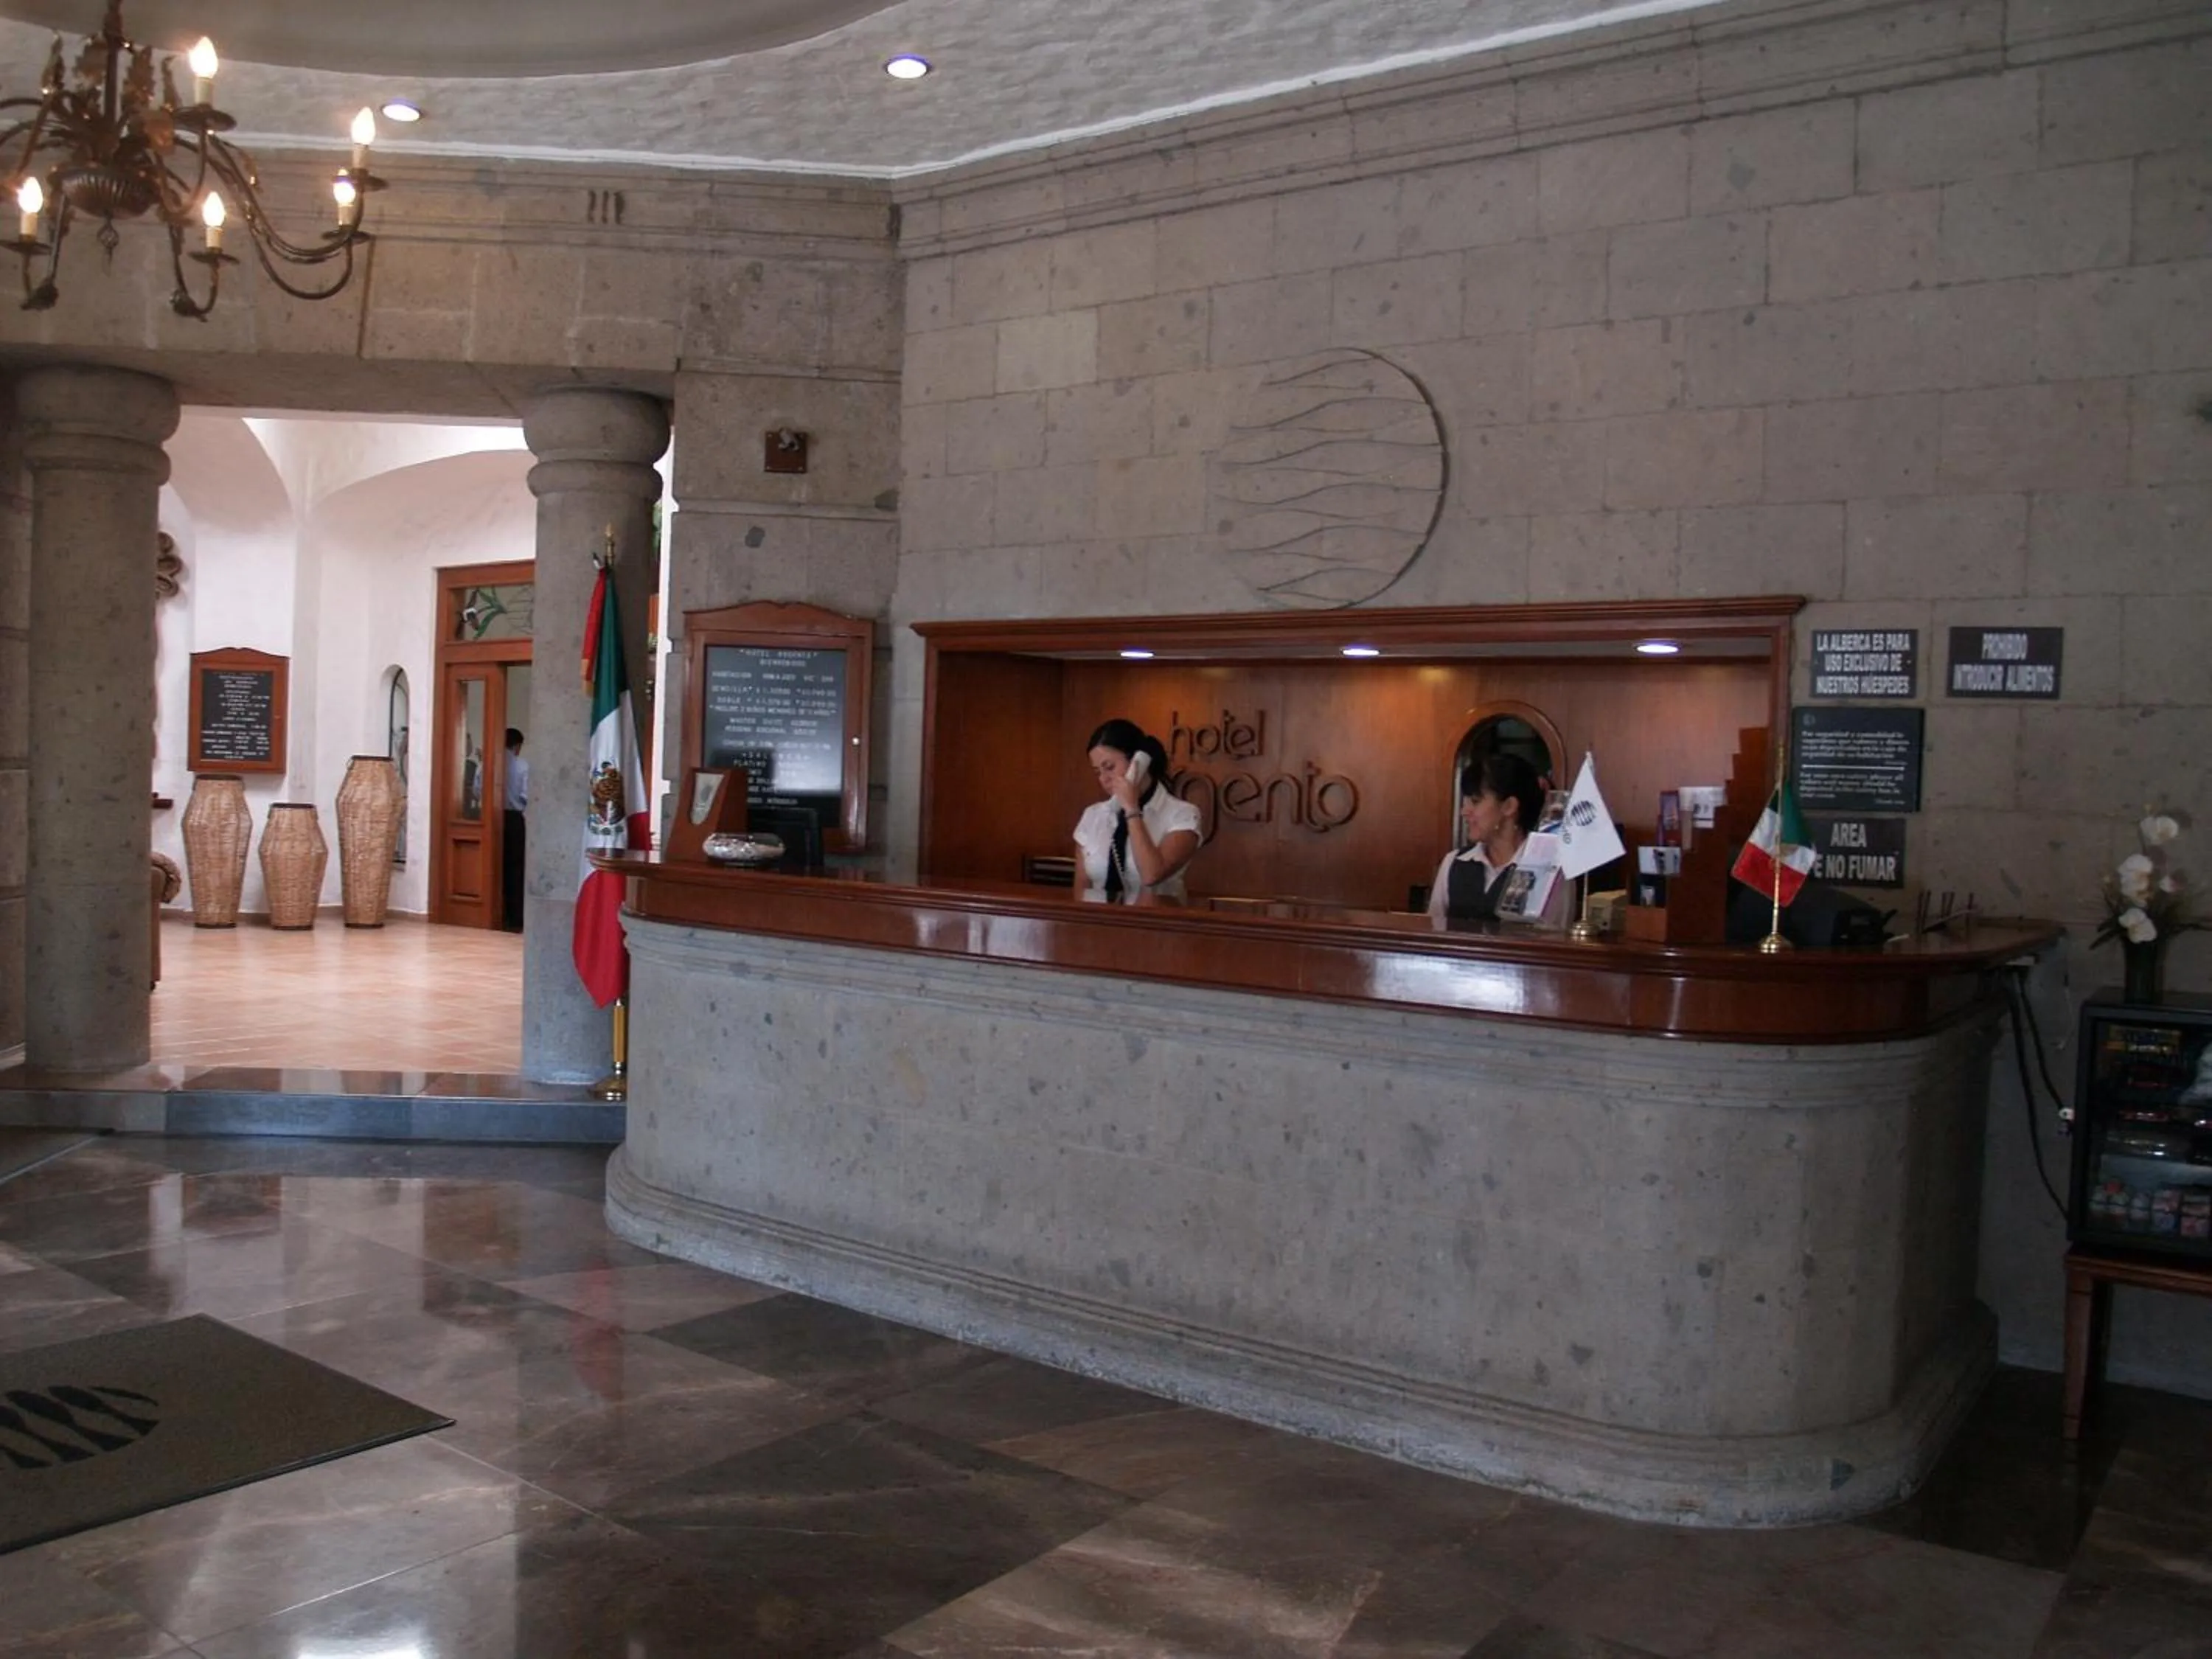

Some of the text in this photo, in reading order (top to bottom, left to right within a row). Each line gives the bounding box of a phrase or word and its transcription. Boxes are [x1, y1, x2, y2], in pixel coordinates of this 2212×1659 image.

[1816, 633, 1910, 651] LA ALBERCA ES PARA
[1824, 653, 1843, 672] USO
[1890, 653, 1902, 672] DE
[1171, 709, 1266, 760] hotel
[1170, 761, 1360, 848] gento
[1829, 822, 1868, 848] AREA
[1825, 854, 1846, 879] NO
[1848, 855, 1897, 881] FUMAR
